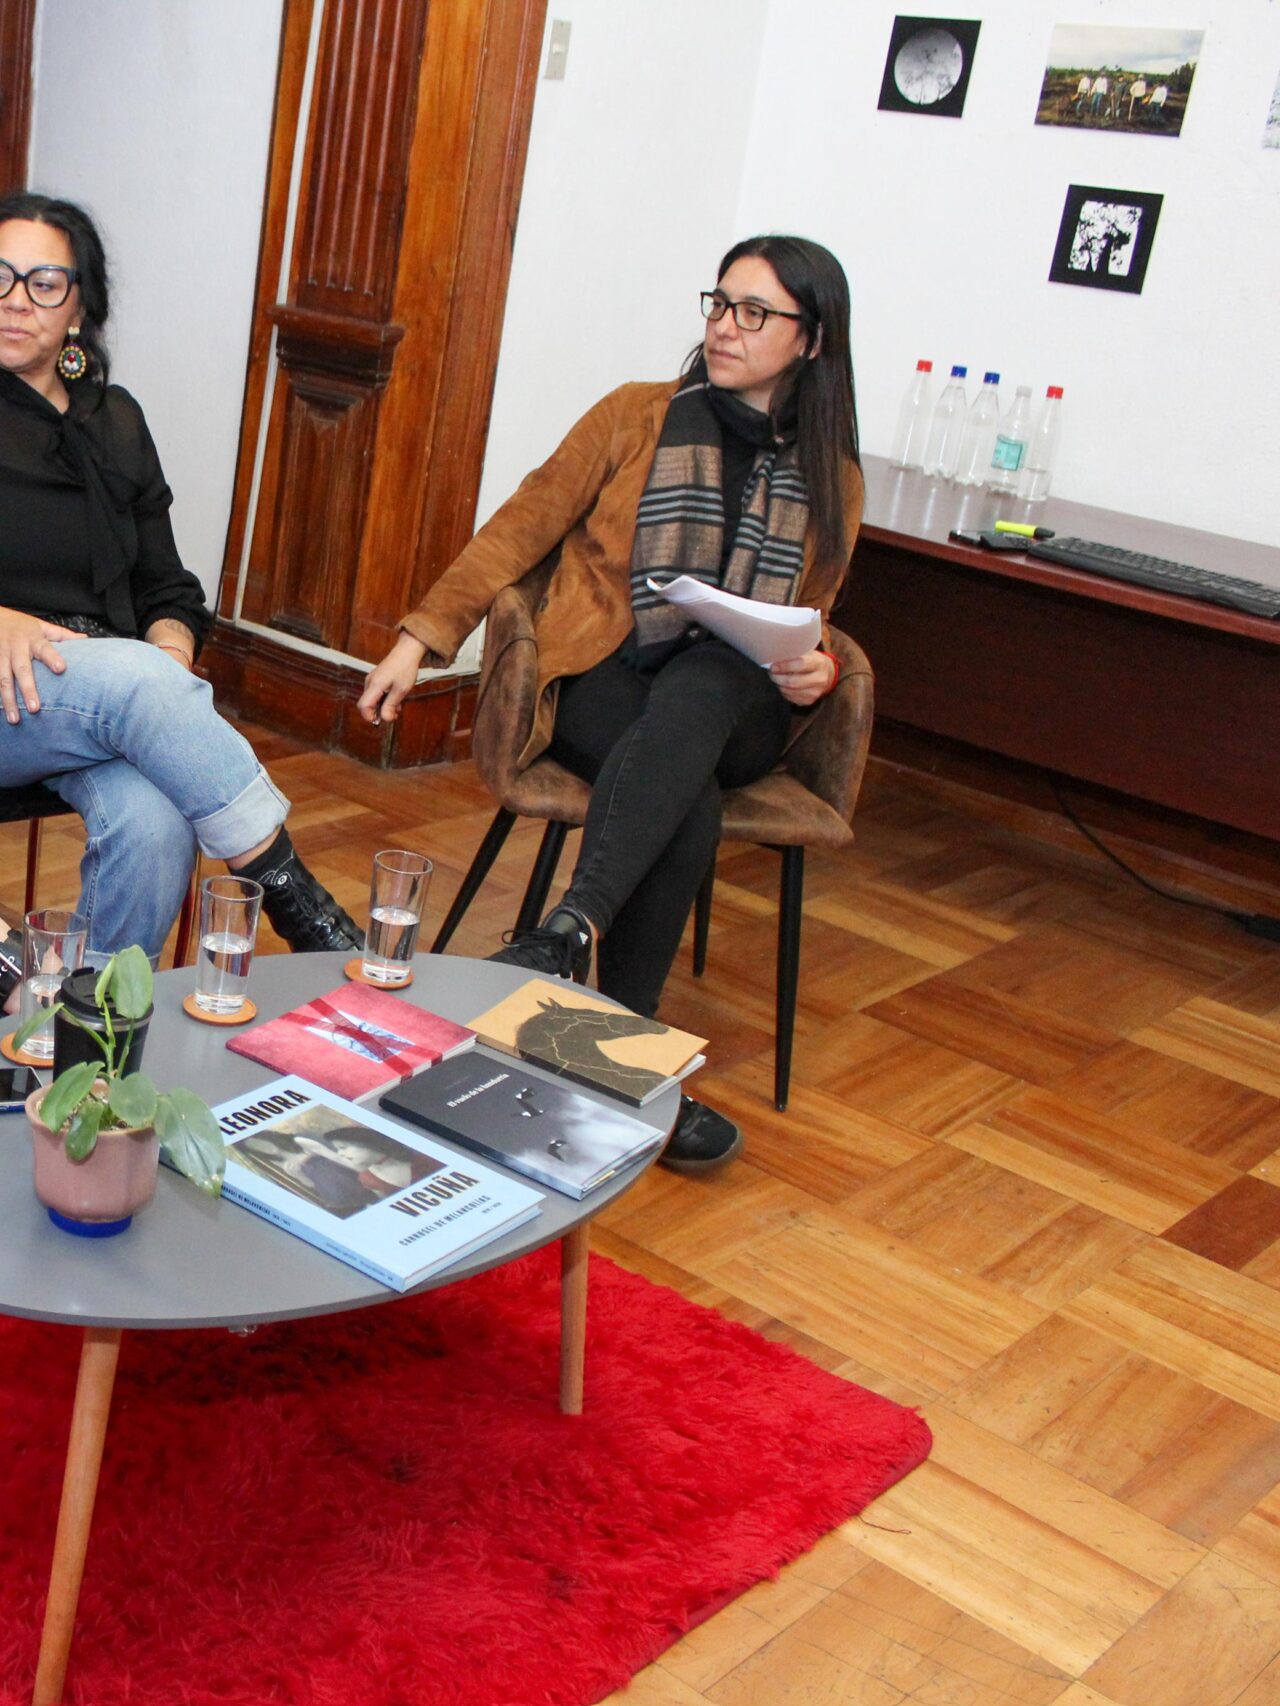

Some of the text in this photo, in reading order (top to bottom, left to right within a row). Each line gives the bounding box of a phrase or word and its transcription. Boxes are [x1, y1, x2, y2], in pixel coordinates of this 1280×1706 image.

[219, 1089, 312, 1136] LEONORA
[389, 1171, 479, 1217] VICUÑA
[433, 1218, 447, 1228] DE
